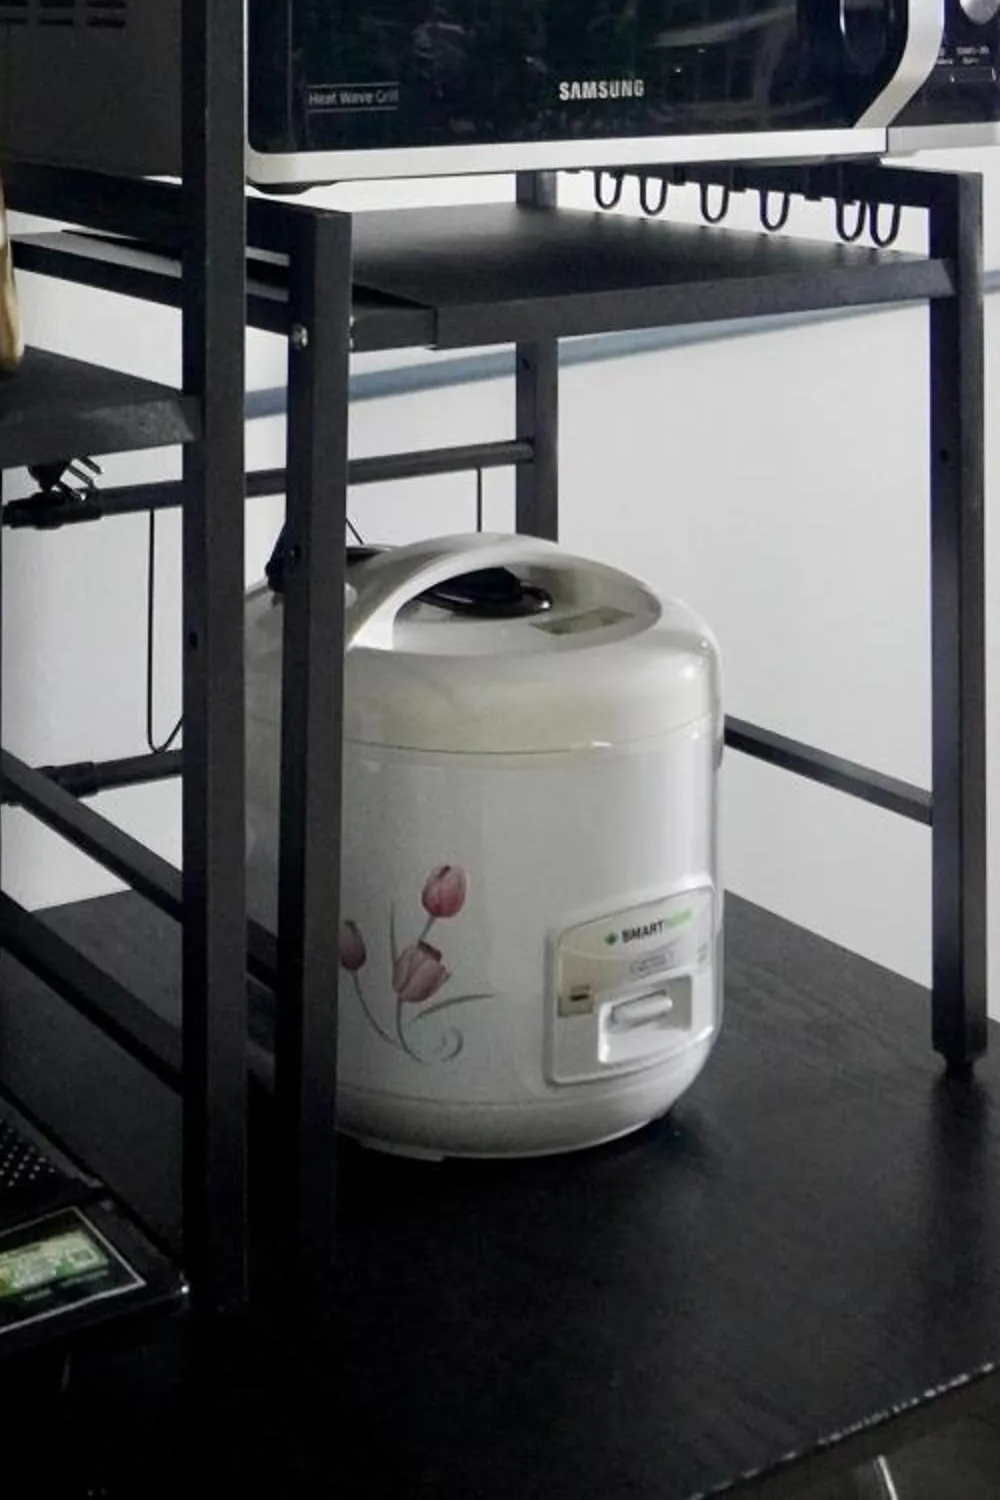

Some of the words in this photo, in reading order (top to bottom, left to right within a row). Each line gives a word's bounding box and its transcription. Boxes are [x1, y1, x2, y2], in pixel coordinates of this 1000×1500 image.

[308, 90, 338, 106] Heat
[559, 78, 646, 101] SAMSUNG
[621, 919, 664, 944] SMART
